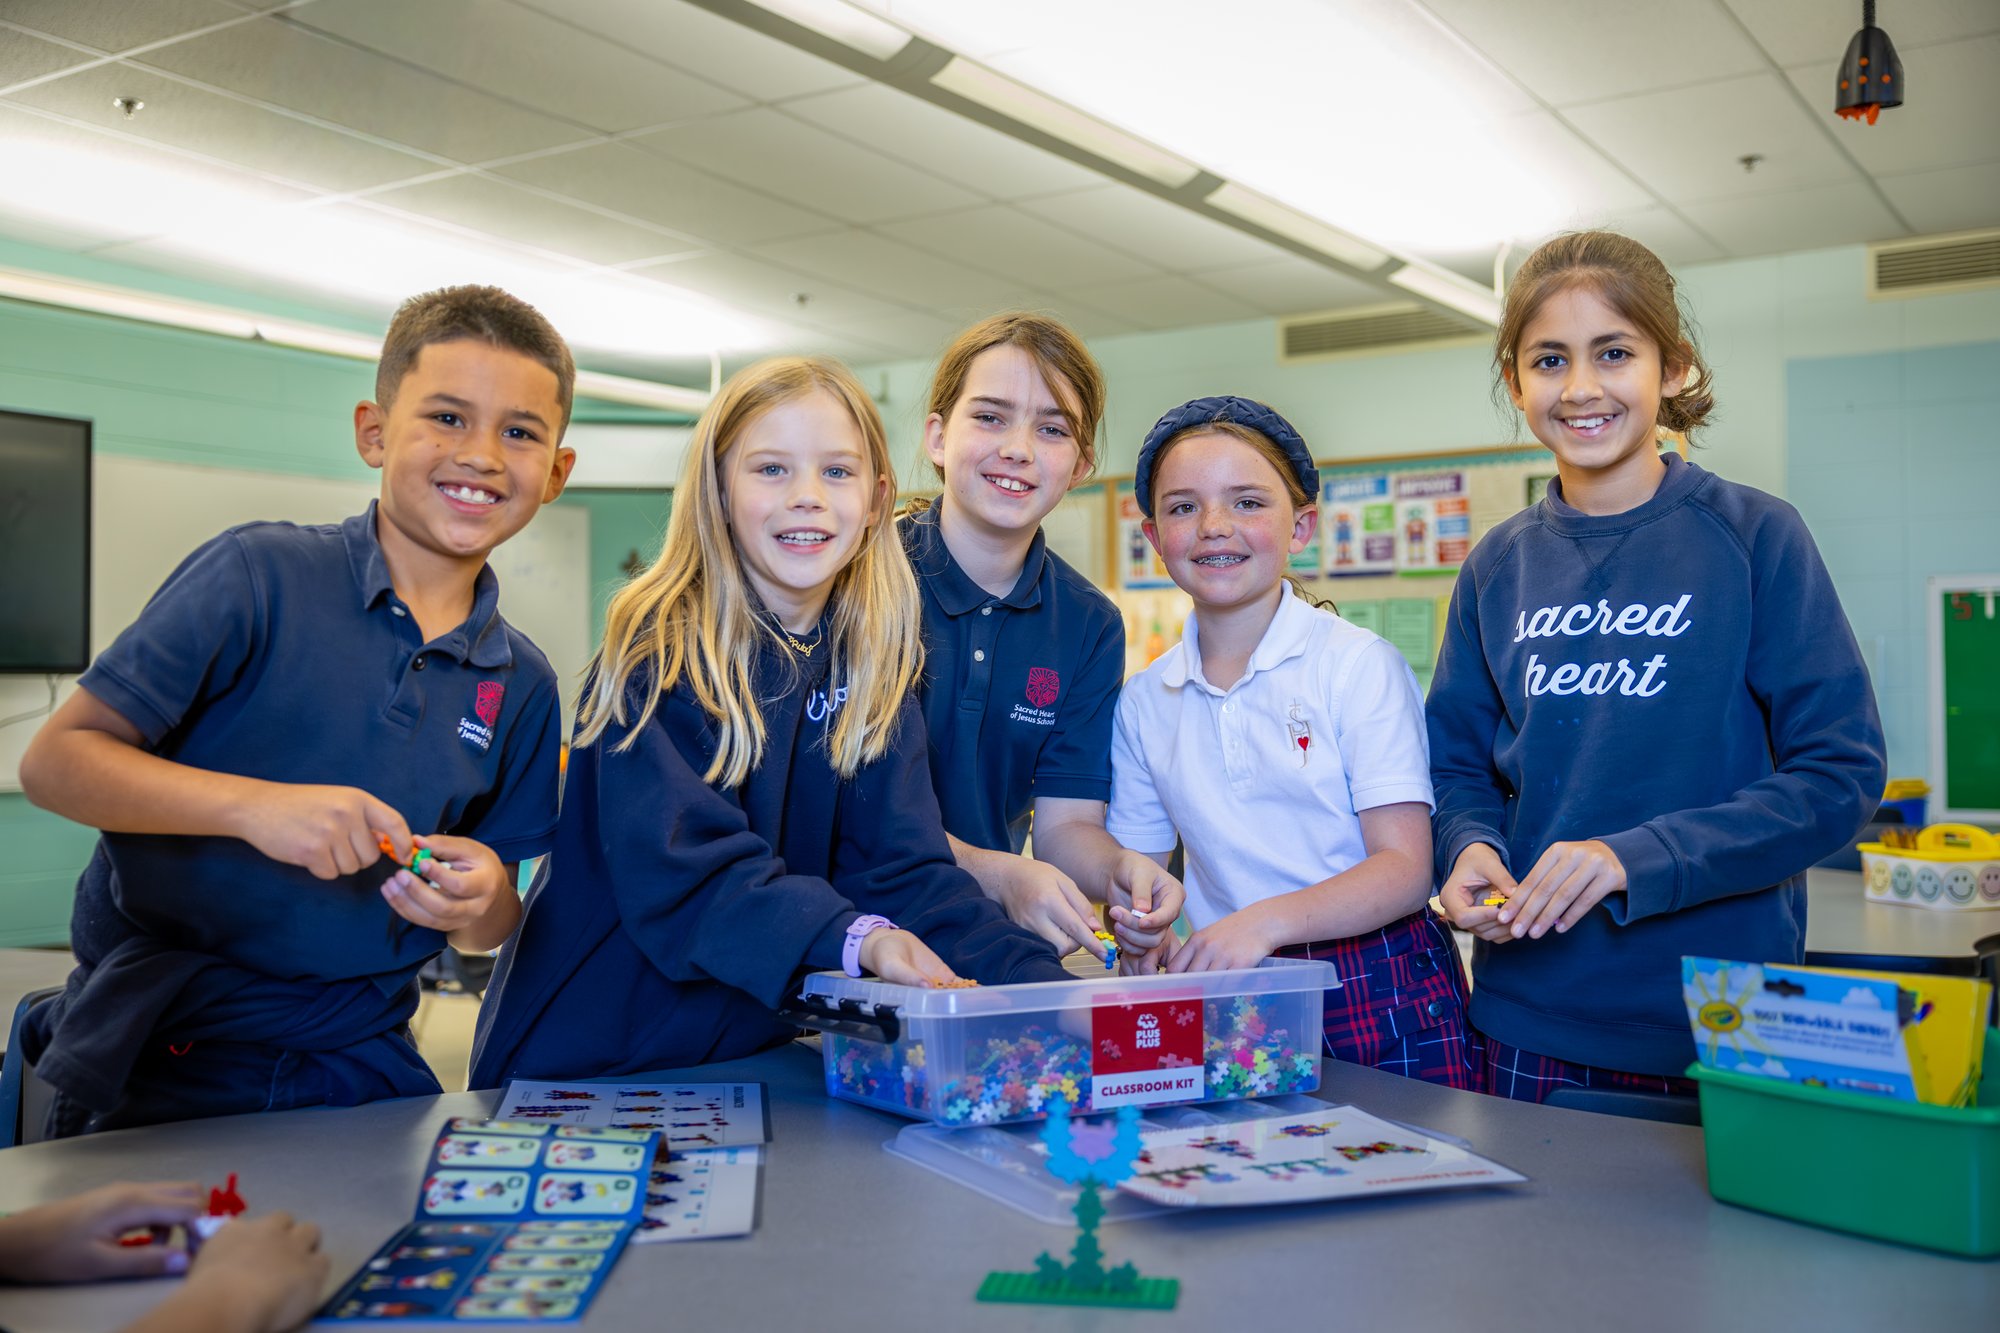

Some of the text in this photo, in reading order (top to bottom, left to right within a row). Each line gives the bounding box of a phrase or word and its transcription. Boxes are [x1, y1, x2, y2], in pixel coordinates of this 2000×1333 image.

[1514, 594, 1692, 642] sacred
[1525, 654, 1667, 698] heart
[1014, 704, 1038, 716] Sacred
[1017, 713, 1036, 723] Jesus
[460, 717, 487, 735] Sacred
[461, 729, 482, 744] Jesus
[1136, 1029, 1161, 1039] PLUS
[1136, 1038, 1161, 1049] PLUS
[1101, 1078, 1195, 1097] CLASSROOM KIT
